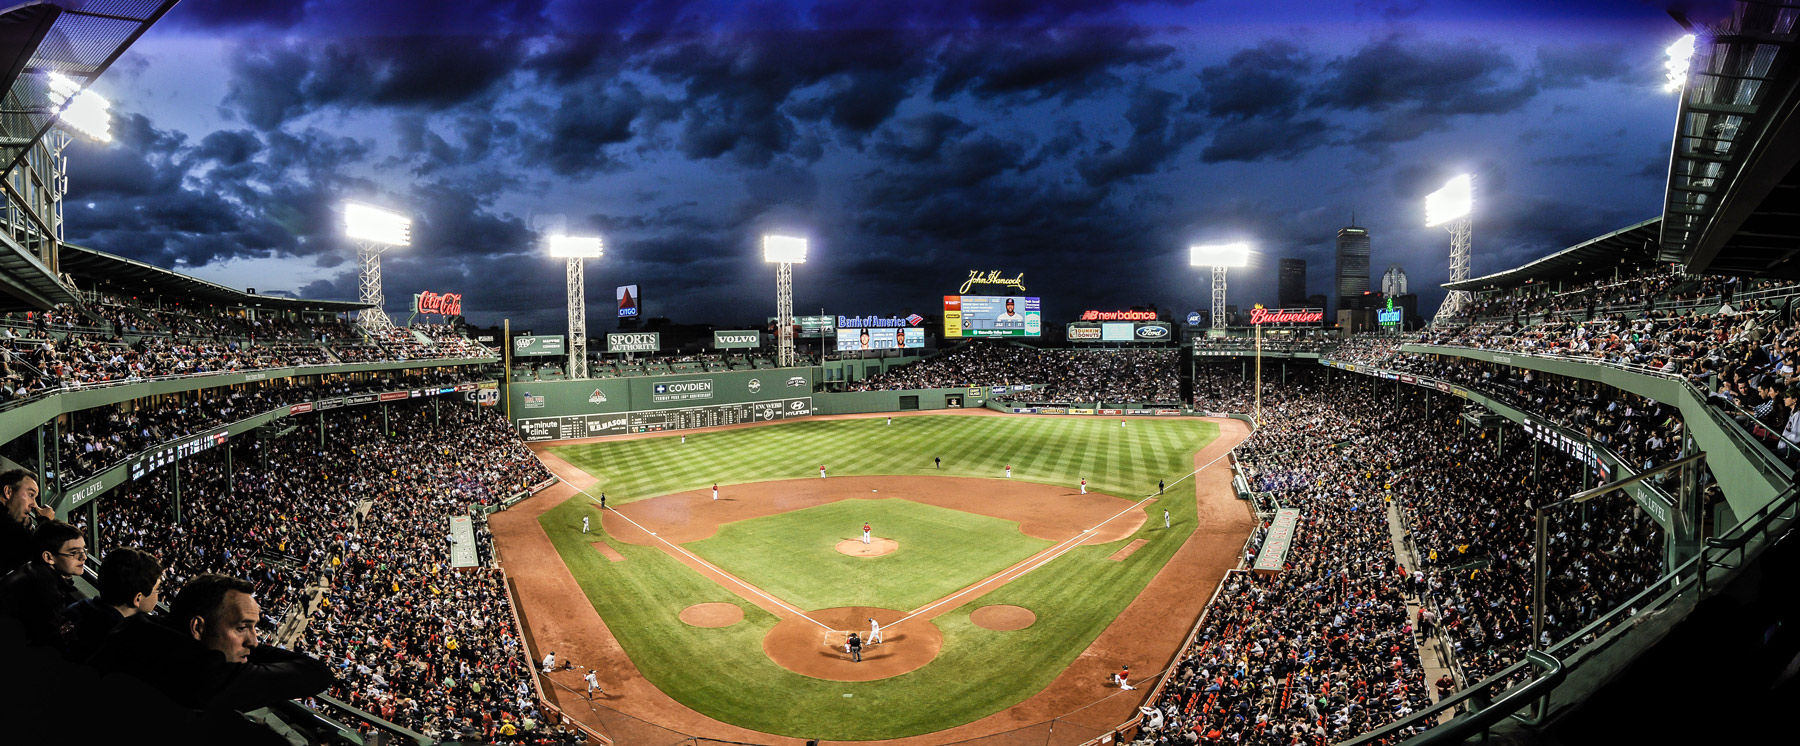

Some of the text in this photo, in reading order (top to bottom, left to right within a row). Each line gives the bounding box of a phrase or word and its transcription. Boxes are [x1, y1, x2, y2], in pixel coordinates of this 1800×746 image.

[960, 270, 1026, 294] John Hancock
[419, 290, 462, 315] Coca-Cola
[619, 308, 636, 316] CITGO
[1099, 312, 1116, 320] new
[1117, 310, 1157, 320] balance
[1250, 308, 1323, 325] Budweiser
[838, 315, 862, 328] Bank
[862, 315, 872, 328] of
[872, 315, 906, 328] America
[1142, 328, 1162, 336] Ford
[611, 334, 656, 345] SPORTS
[669, 382, 711, 393] COVIDIEN
[467, 391, 498, 401] Gulf
[534, 420, 558, 429] minute
[530, 428, 549, 436] clinic
[72, 480, 103, 504] EMC LEVEL
[1637, 487, 1666, 522] EMC LEVEL
